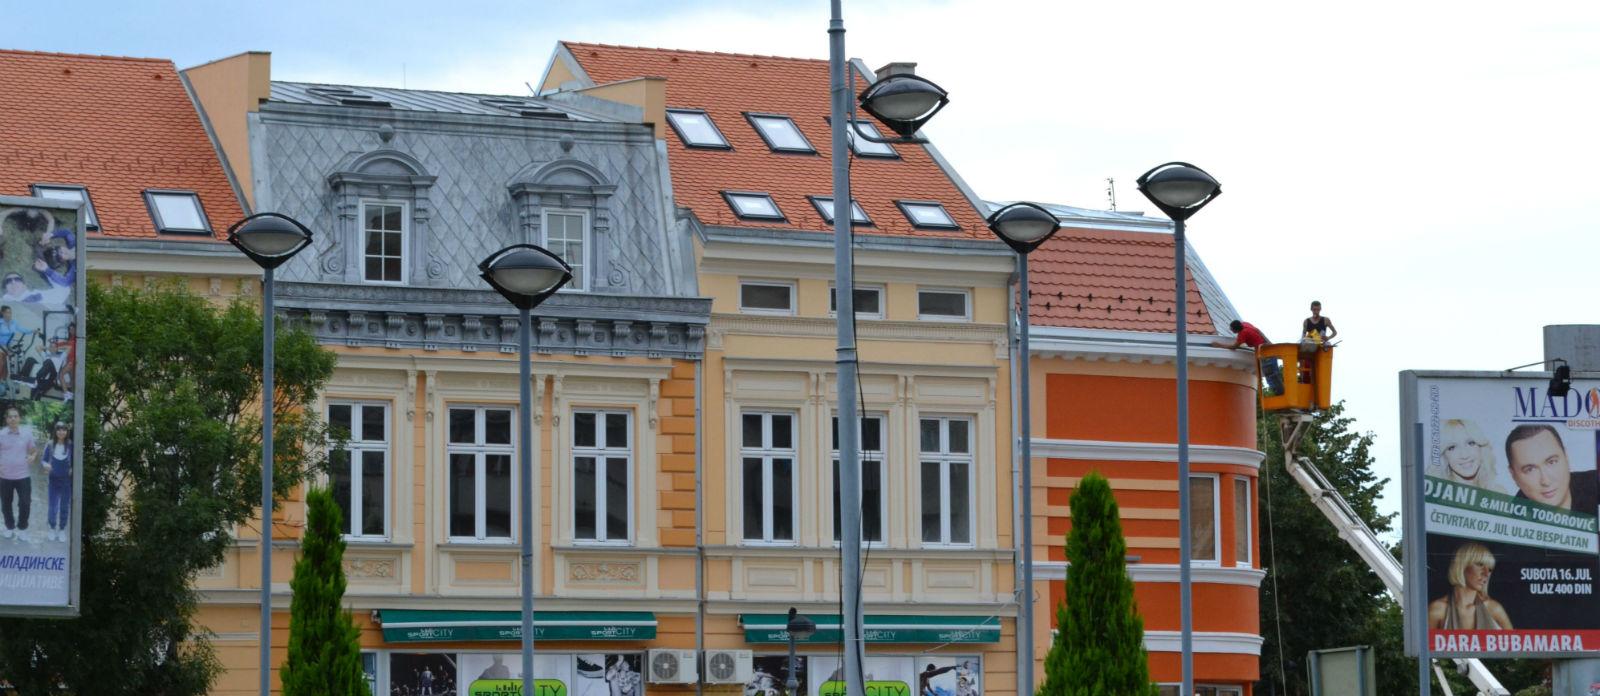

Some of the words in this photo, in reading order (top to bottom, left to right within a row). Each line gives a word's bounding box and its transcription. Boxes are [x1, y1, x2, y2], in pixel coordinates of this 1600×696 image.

[1424, 479, 1476, 506] DJANI
[1532, 508, 1595, 531] TODOROVIĆ
[1430, 509, 1476, 530] ČETVRTAK
[1511, 527, 1534, 541] ULAZ
[1536, 531, 1589, 549] BESPLATAN
[1520, 567, 1558, 581] SUBOTA
[1530, 583, 1554, 595] ULAZ
[1555, 584, 1573, 595] 400
[1574, 584, 1592, 595] DIN
[1435, 635, 1481, 652] DARA
[1486, 635, 1583, 651] BUBAMARA
